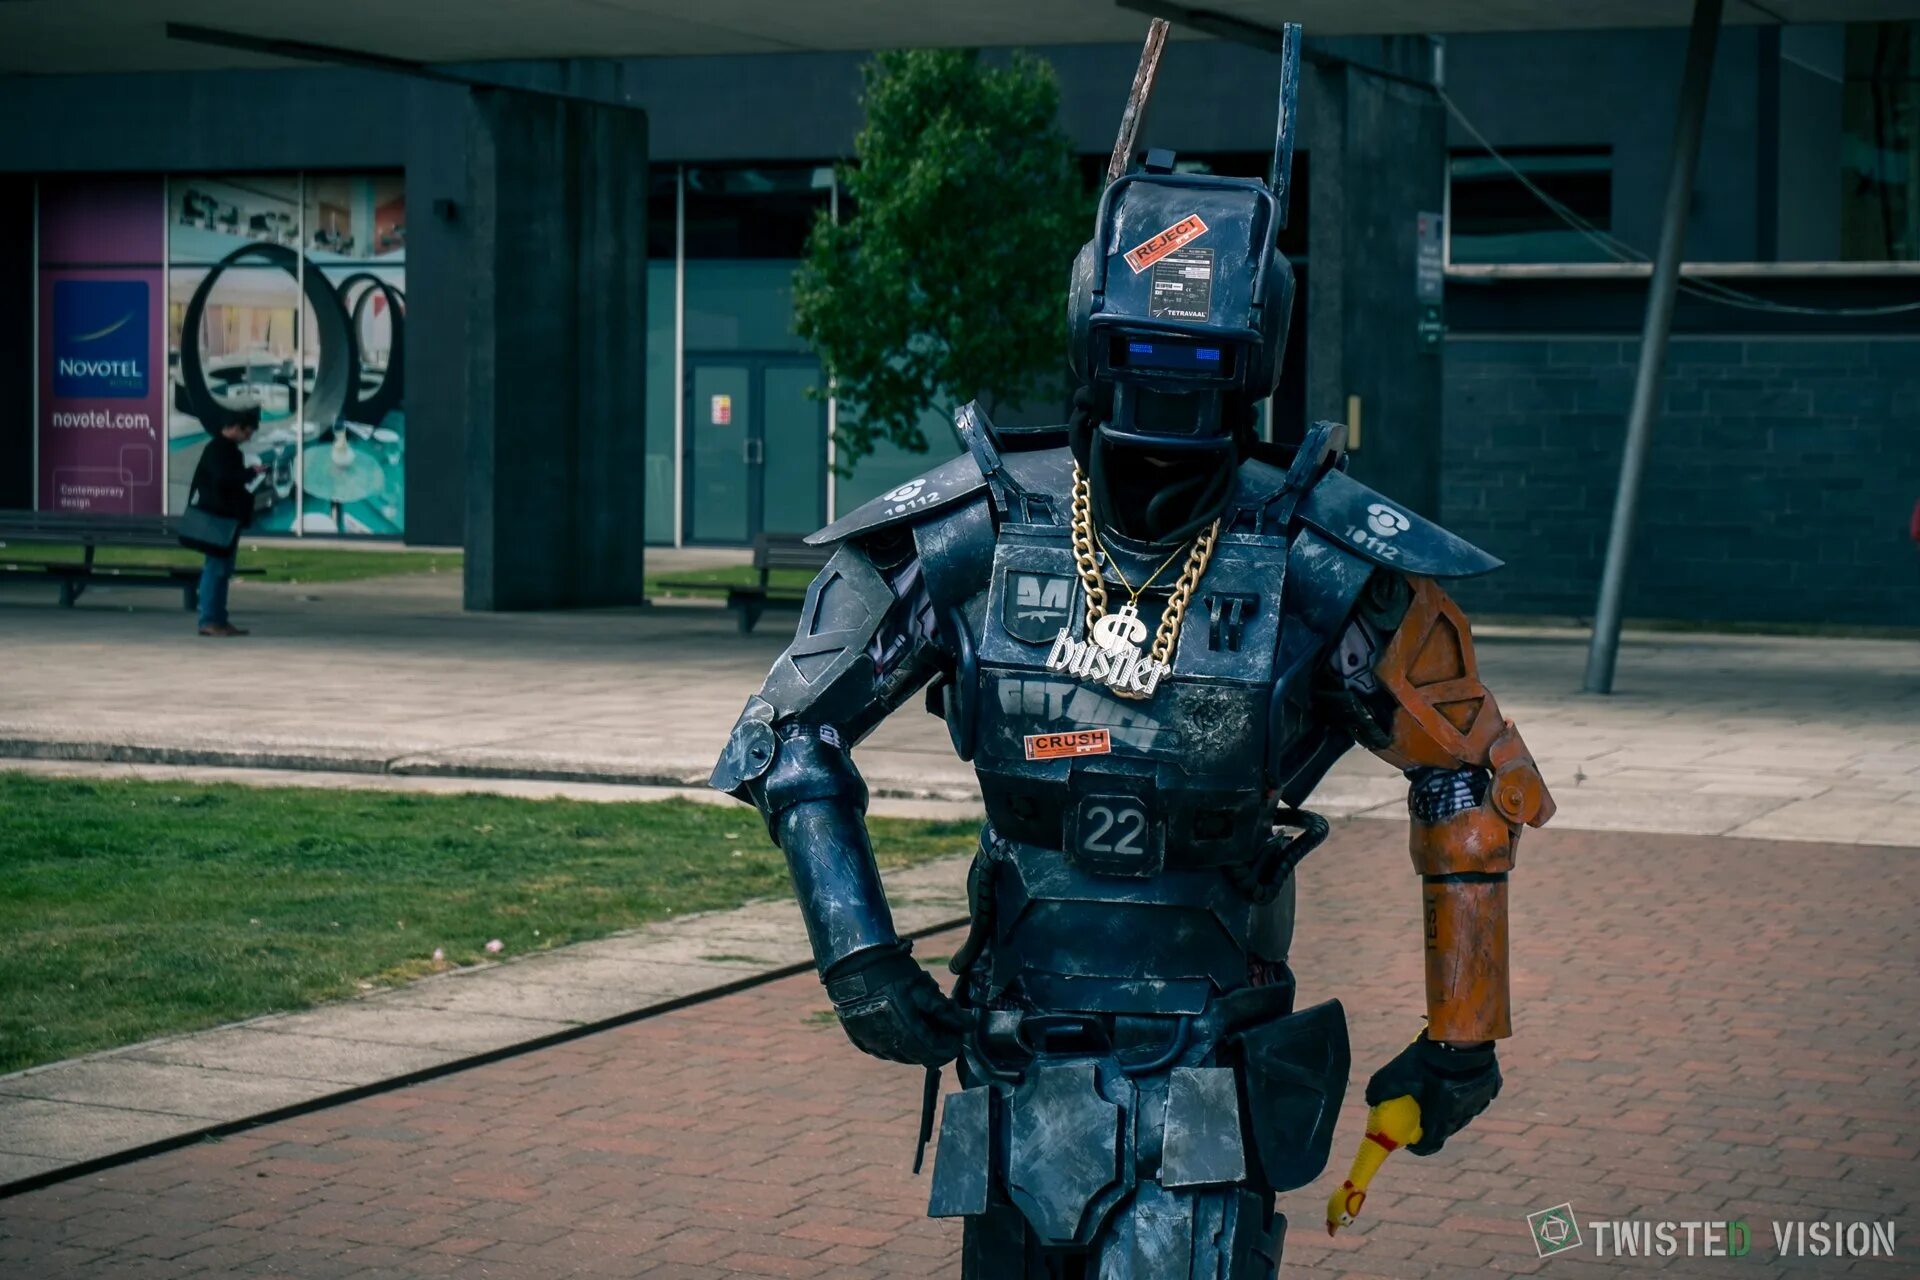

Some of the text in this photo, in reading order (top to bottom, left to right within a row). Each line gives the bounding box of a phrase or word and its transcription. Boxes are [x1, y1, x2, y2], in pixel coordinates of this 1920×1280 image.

[1136, 217, 1197, 260] REJECT
[1167, 309, 1206, 318] TETRAVAAL
[60, 357, 142, 378] NOVOTEL
[53, 409, 150, 430] novotel.com
[60, 484, 125, 498] Contemporary
[60, 497, 91, 510] design
[884, 491, 941, 517] 10112
[1344, 524, 1399, 561] 10112
[1035, 732, 1105, 749] CRUSH
[1085, 806, 1146, 854] 22
